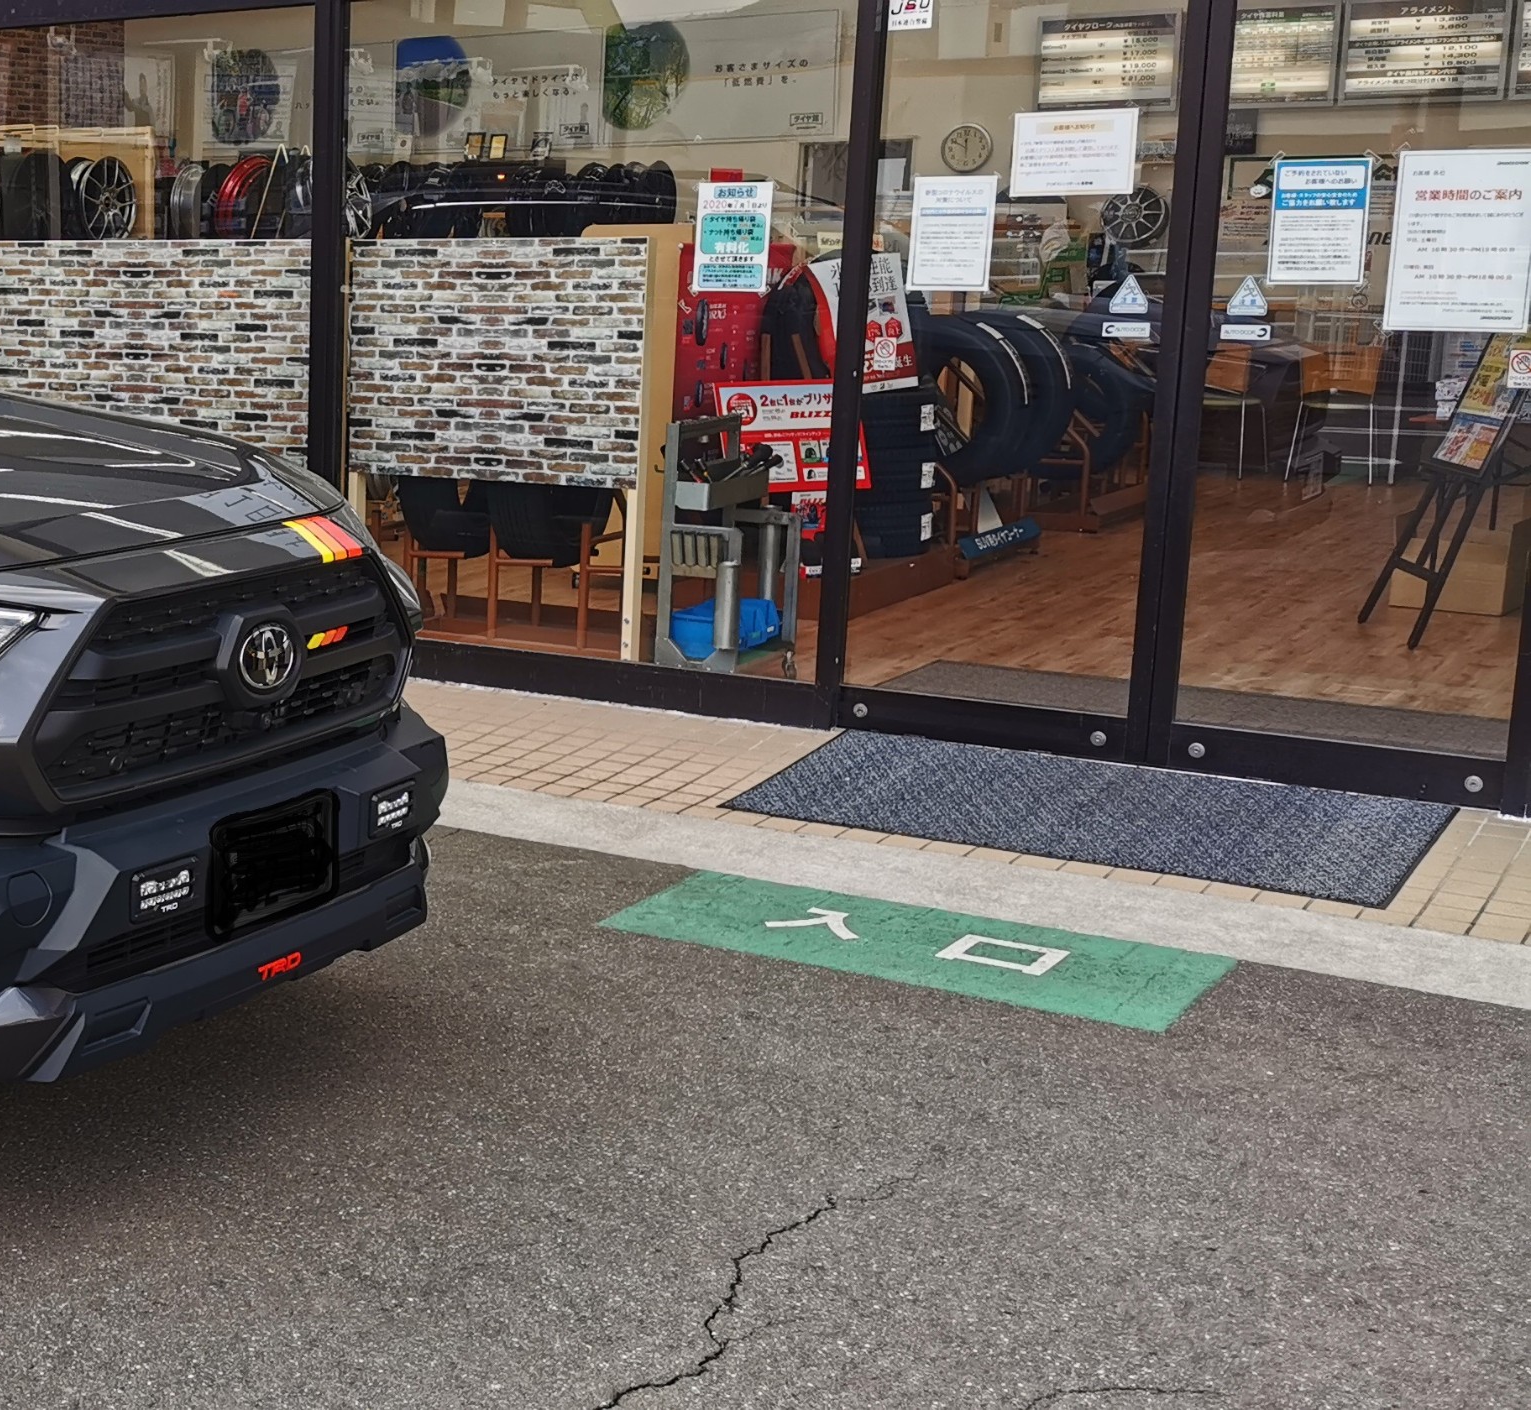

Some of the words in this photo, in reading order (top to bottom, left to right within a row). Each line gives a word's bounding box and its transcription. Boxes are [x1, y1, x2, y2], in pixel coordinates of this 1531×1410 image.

[715, 59, 808, 73] お客さまサイズの
[718, 187, 754, 198] お知らせ
[1415, 188, 1523, 201] 営業時間のご案内
[161, 902, 179, 913] TRD
[257, 951, 302, 981] TRD
